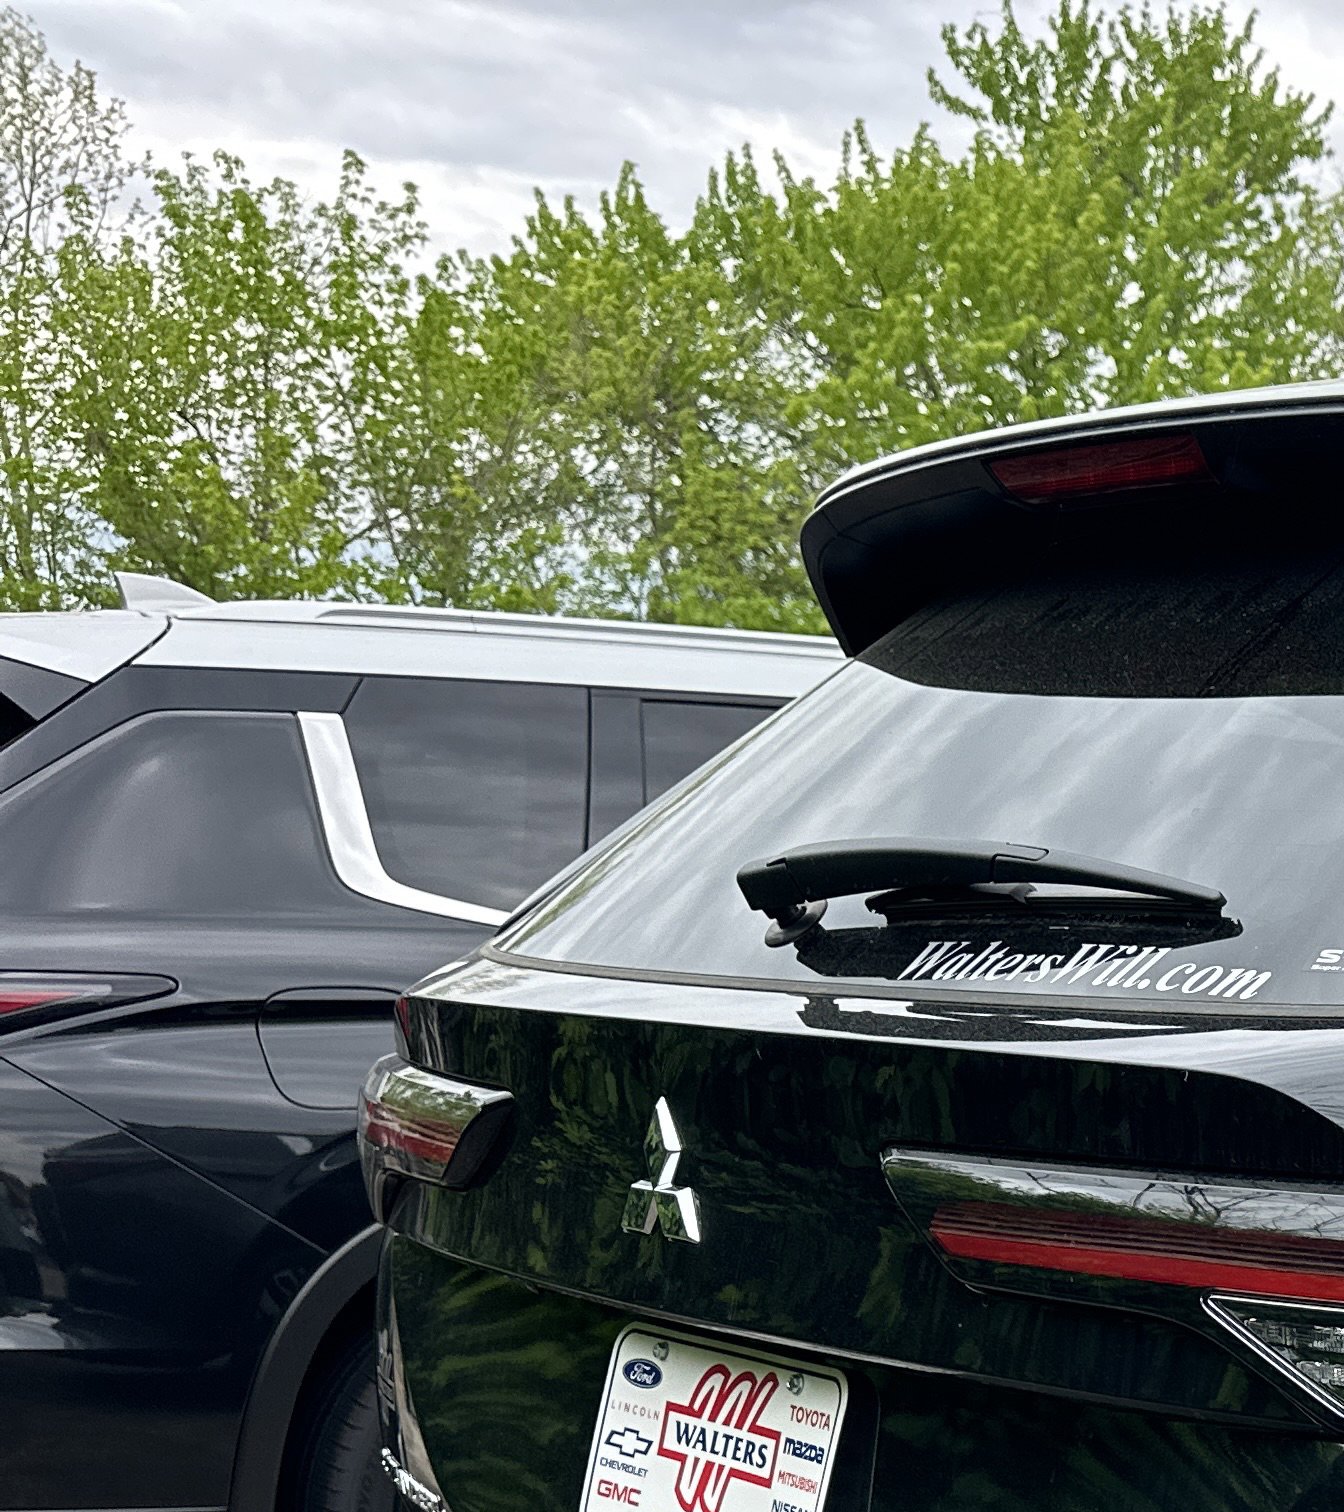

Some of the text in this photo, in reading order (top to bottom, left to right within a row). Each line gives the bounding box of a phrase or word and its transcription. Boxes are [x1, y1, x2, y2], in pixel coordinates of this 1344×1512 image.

[898, 941, 1274, 999] WaltersWill.com
[610, 1401, 660, 1421] LINCOLN
[790, 1404, 832, 1432] TOYOTA
[674, 1420, 769, 1470] WALTERS
[599, 1457, 649, 1479] CHEVROLET
[597, 1479, 642, 1508] GMC
[777, 1470, 818, 1495] MITSUBISHI
